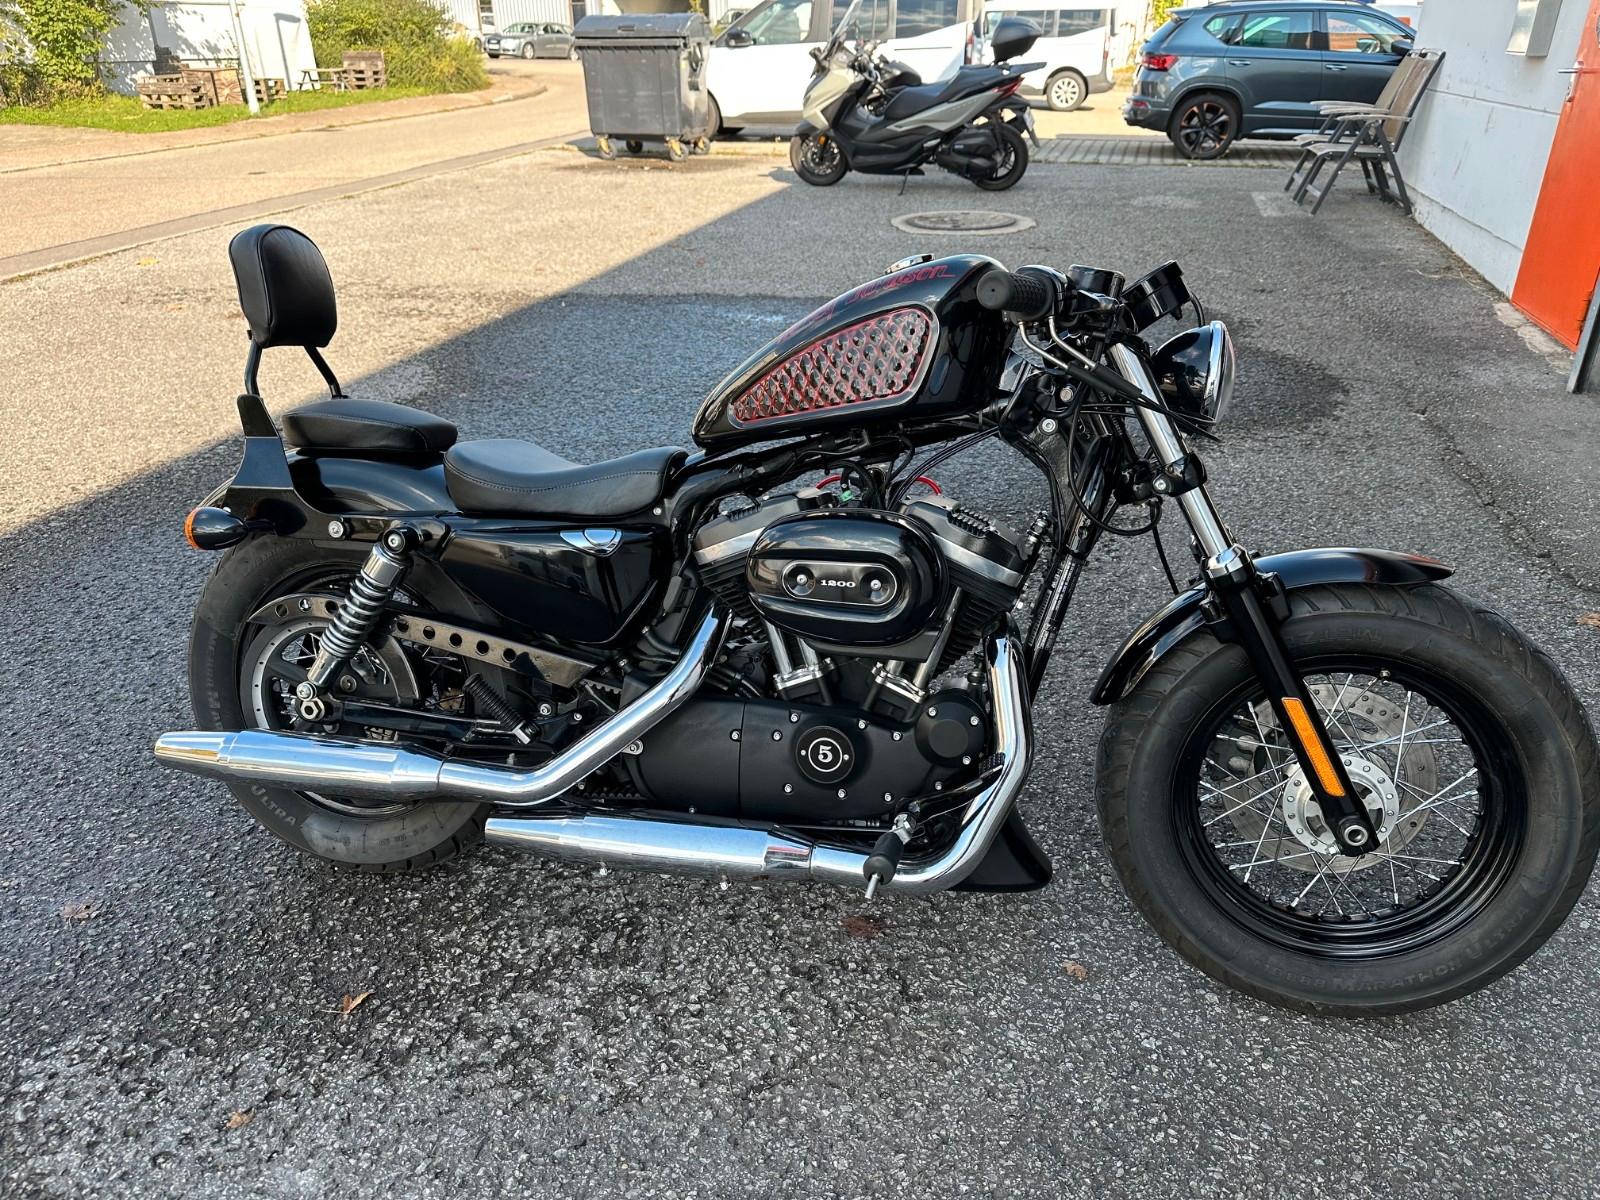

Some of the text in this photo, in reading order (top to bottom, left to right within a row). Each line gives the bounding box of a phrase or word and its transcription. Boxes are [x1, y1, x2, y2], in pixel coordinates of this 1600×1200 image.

[820, 580, 856, 588] 1200
[817, 745, 834, 763] 5
[250, 784, 297, 826] ULTRA
